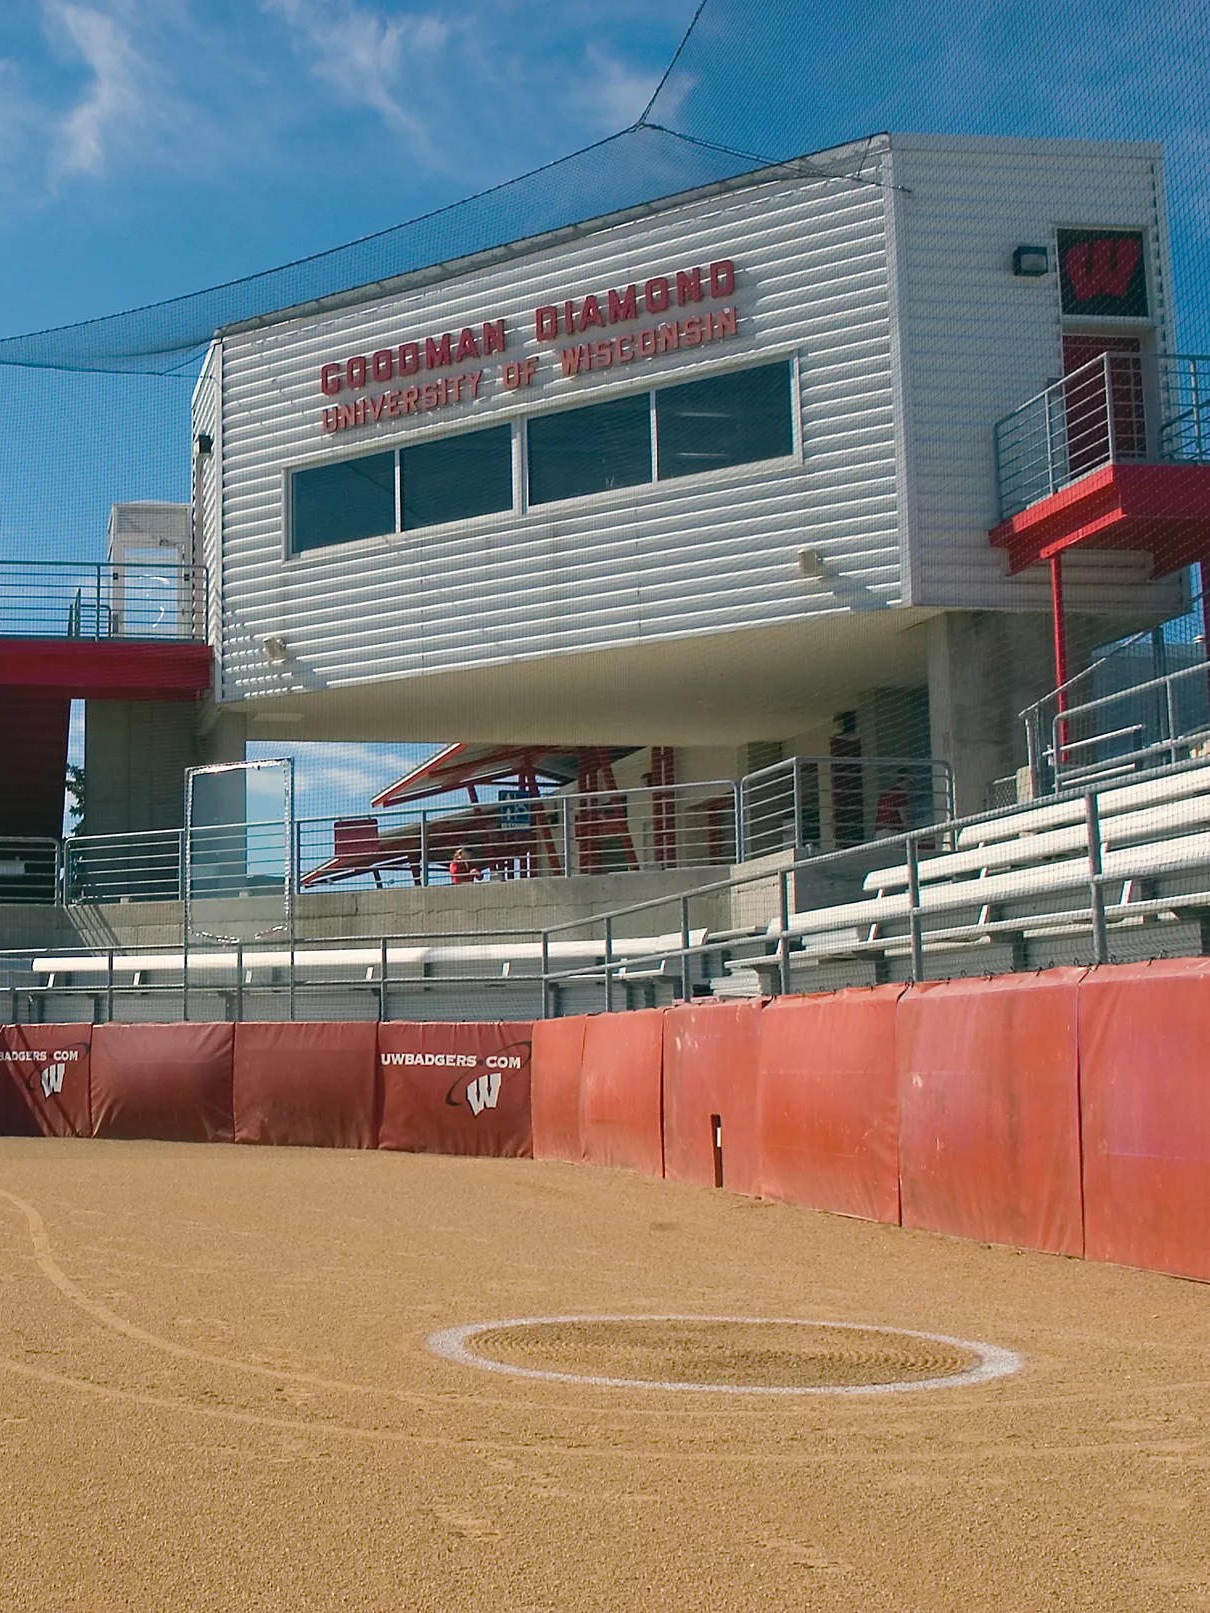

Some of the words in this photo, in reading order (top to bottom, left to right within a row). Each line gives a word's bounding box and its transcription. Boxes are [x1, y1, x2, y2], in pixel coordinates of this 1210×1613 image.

[321, 319, 506, 395] GOODMAN
[535, 259, 734, 342] DIAMOND
[322, 370, 483, 434] UNIVERSITY
[502, 356, 539, 390] OF
[560, 306, 737, 376] WISCONSIN
[41, 1063, 66, 1099] W
[466, 1072, 502, 1117] W
